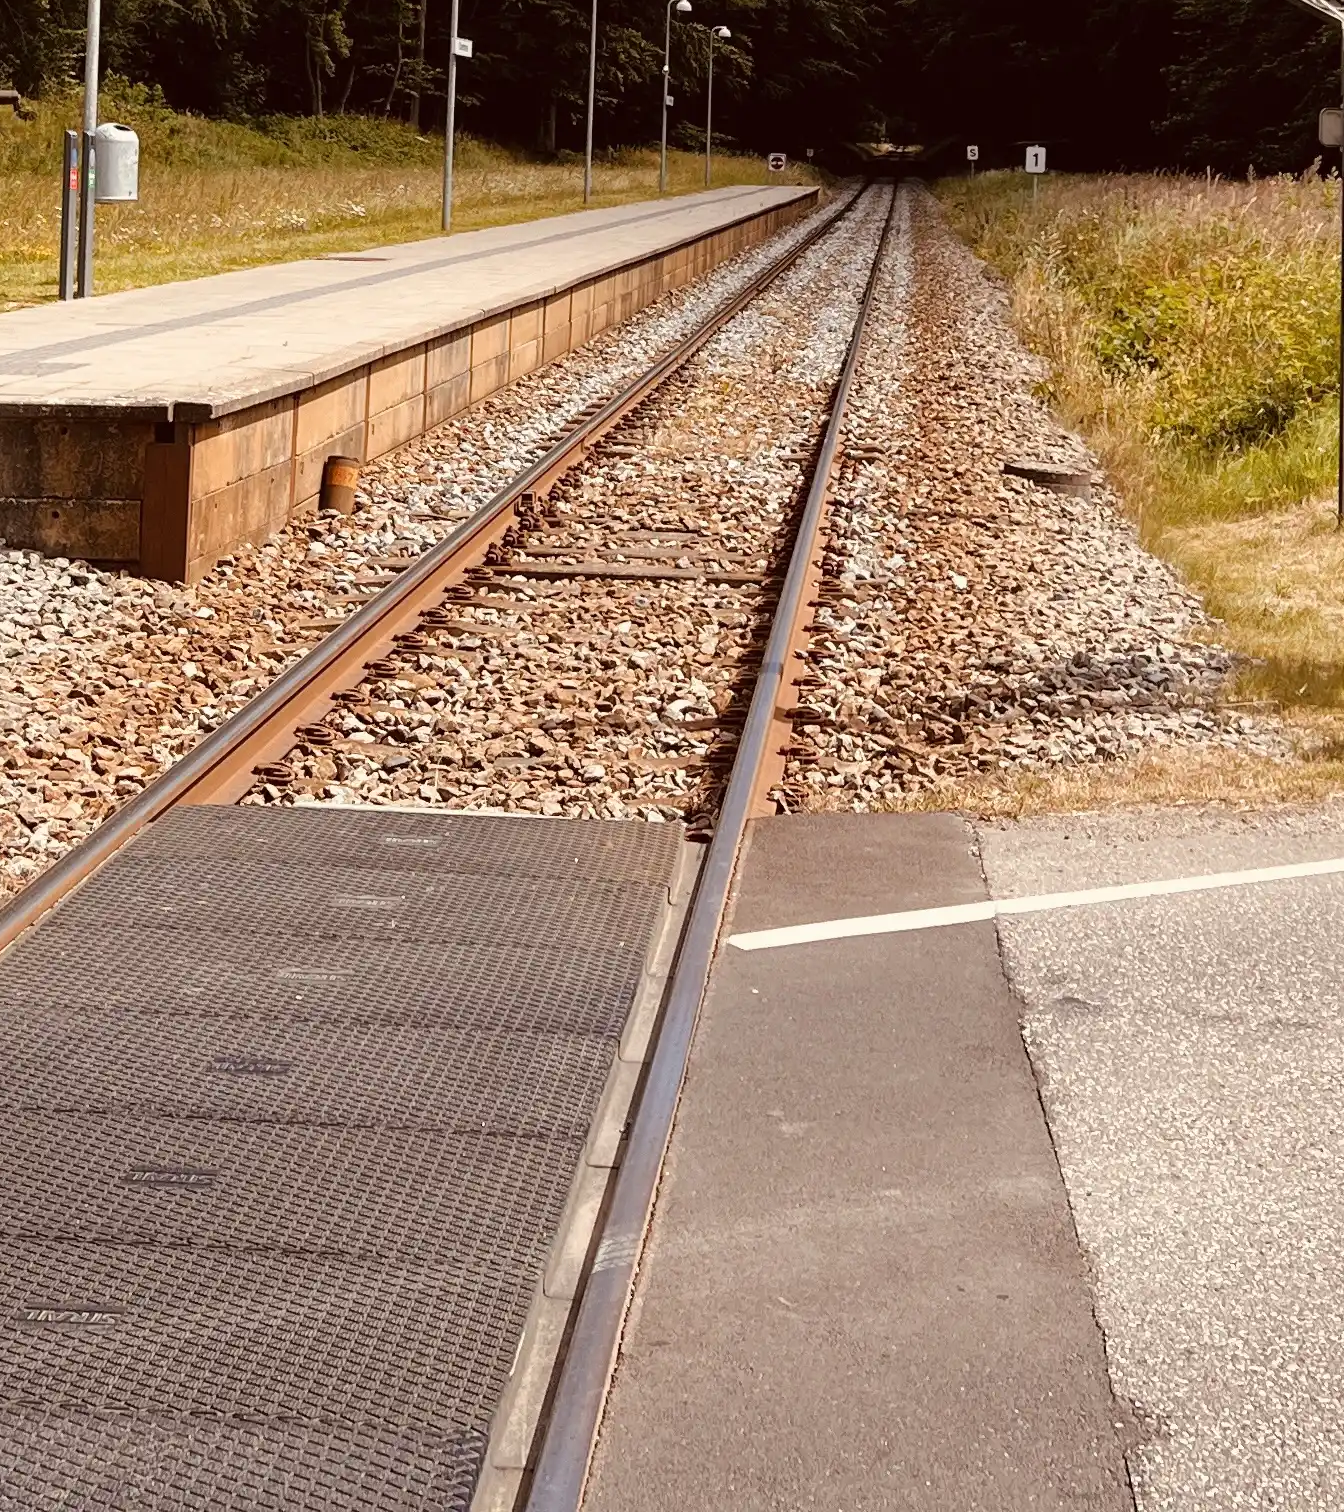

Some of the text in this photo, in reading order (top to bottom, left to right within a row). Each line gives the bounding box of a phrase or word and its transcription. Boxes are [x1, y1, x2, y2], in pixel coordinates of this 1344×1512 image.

[969, 148, 977, 157] S
[1032, 152, 1039, 168] 1
[23, 1308, 122, 1324] STRAIL
